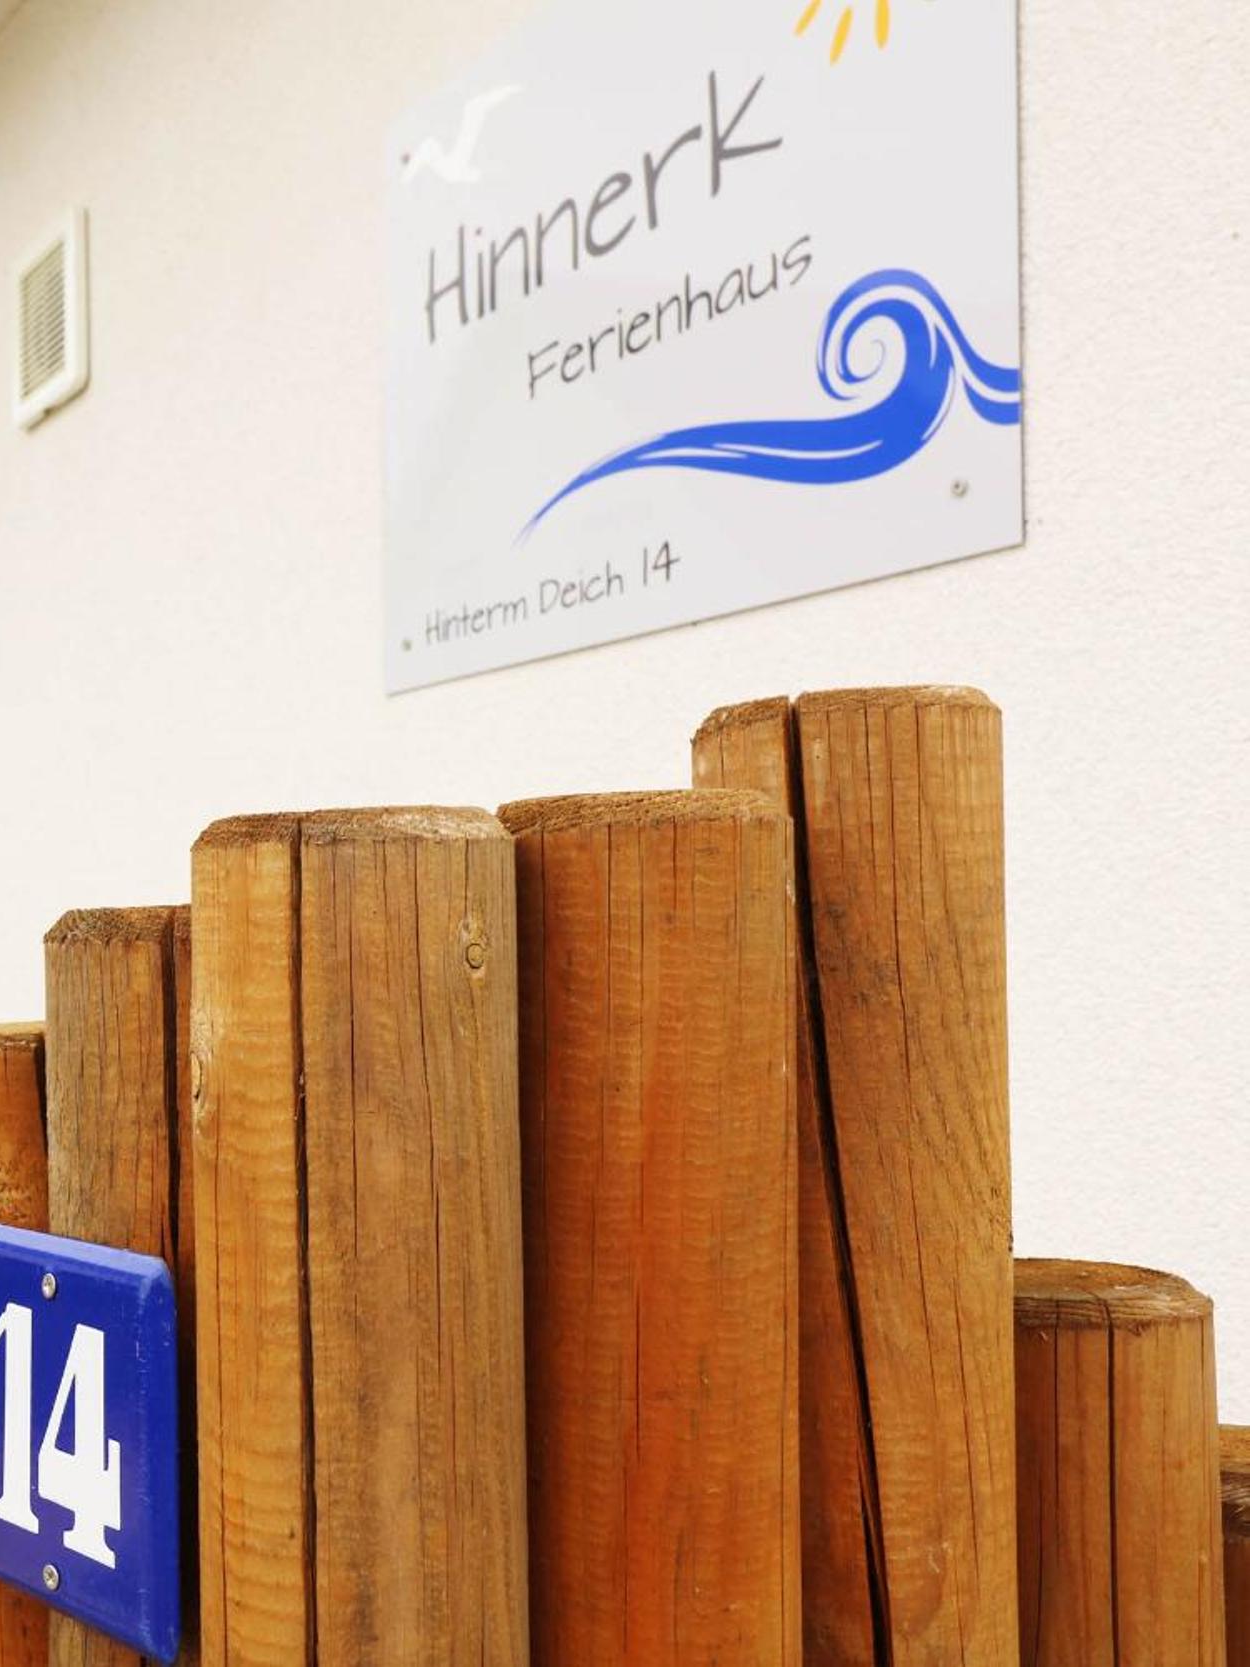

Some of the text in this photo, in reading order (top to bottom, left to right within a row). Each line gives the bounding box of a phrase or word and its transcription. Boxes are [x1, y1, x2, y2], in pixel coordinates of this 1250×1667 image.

[425, 70, 784, 345] Hinnerk
[528, 235, 813, 399] Ferienhaus
[425, 540, 681, 646] Hinterm Deich 14
